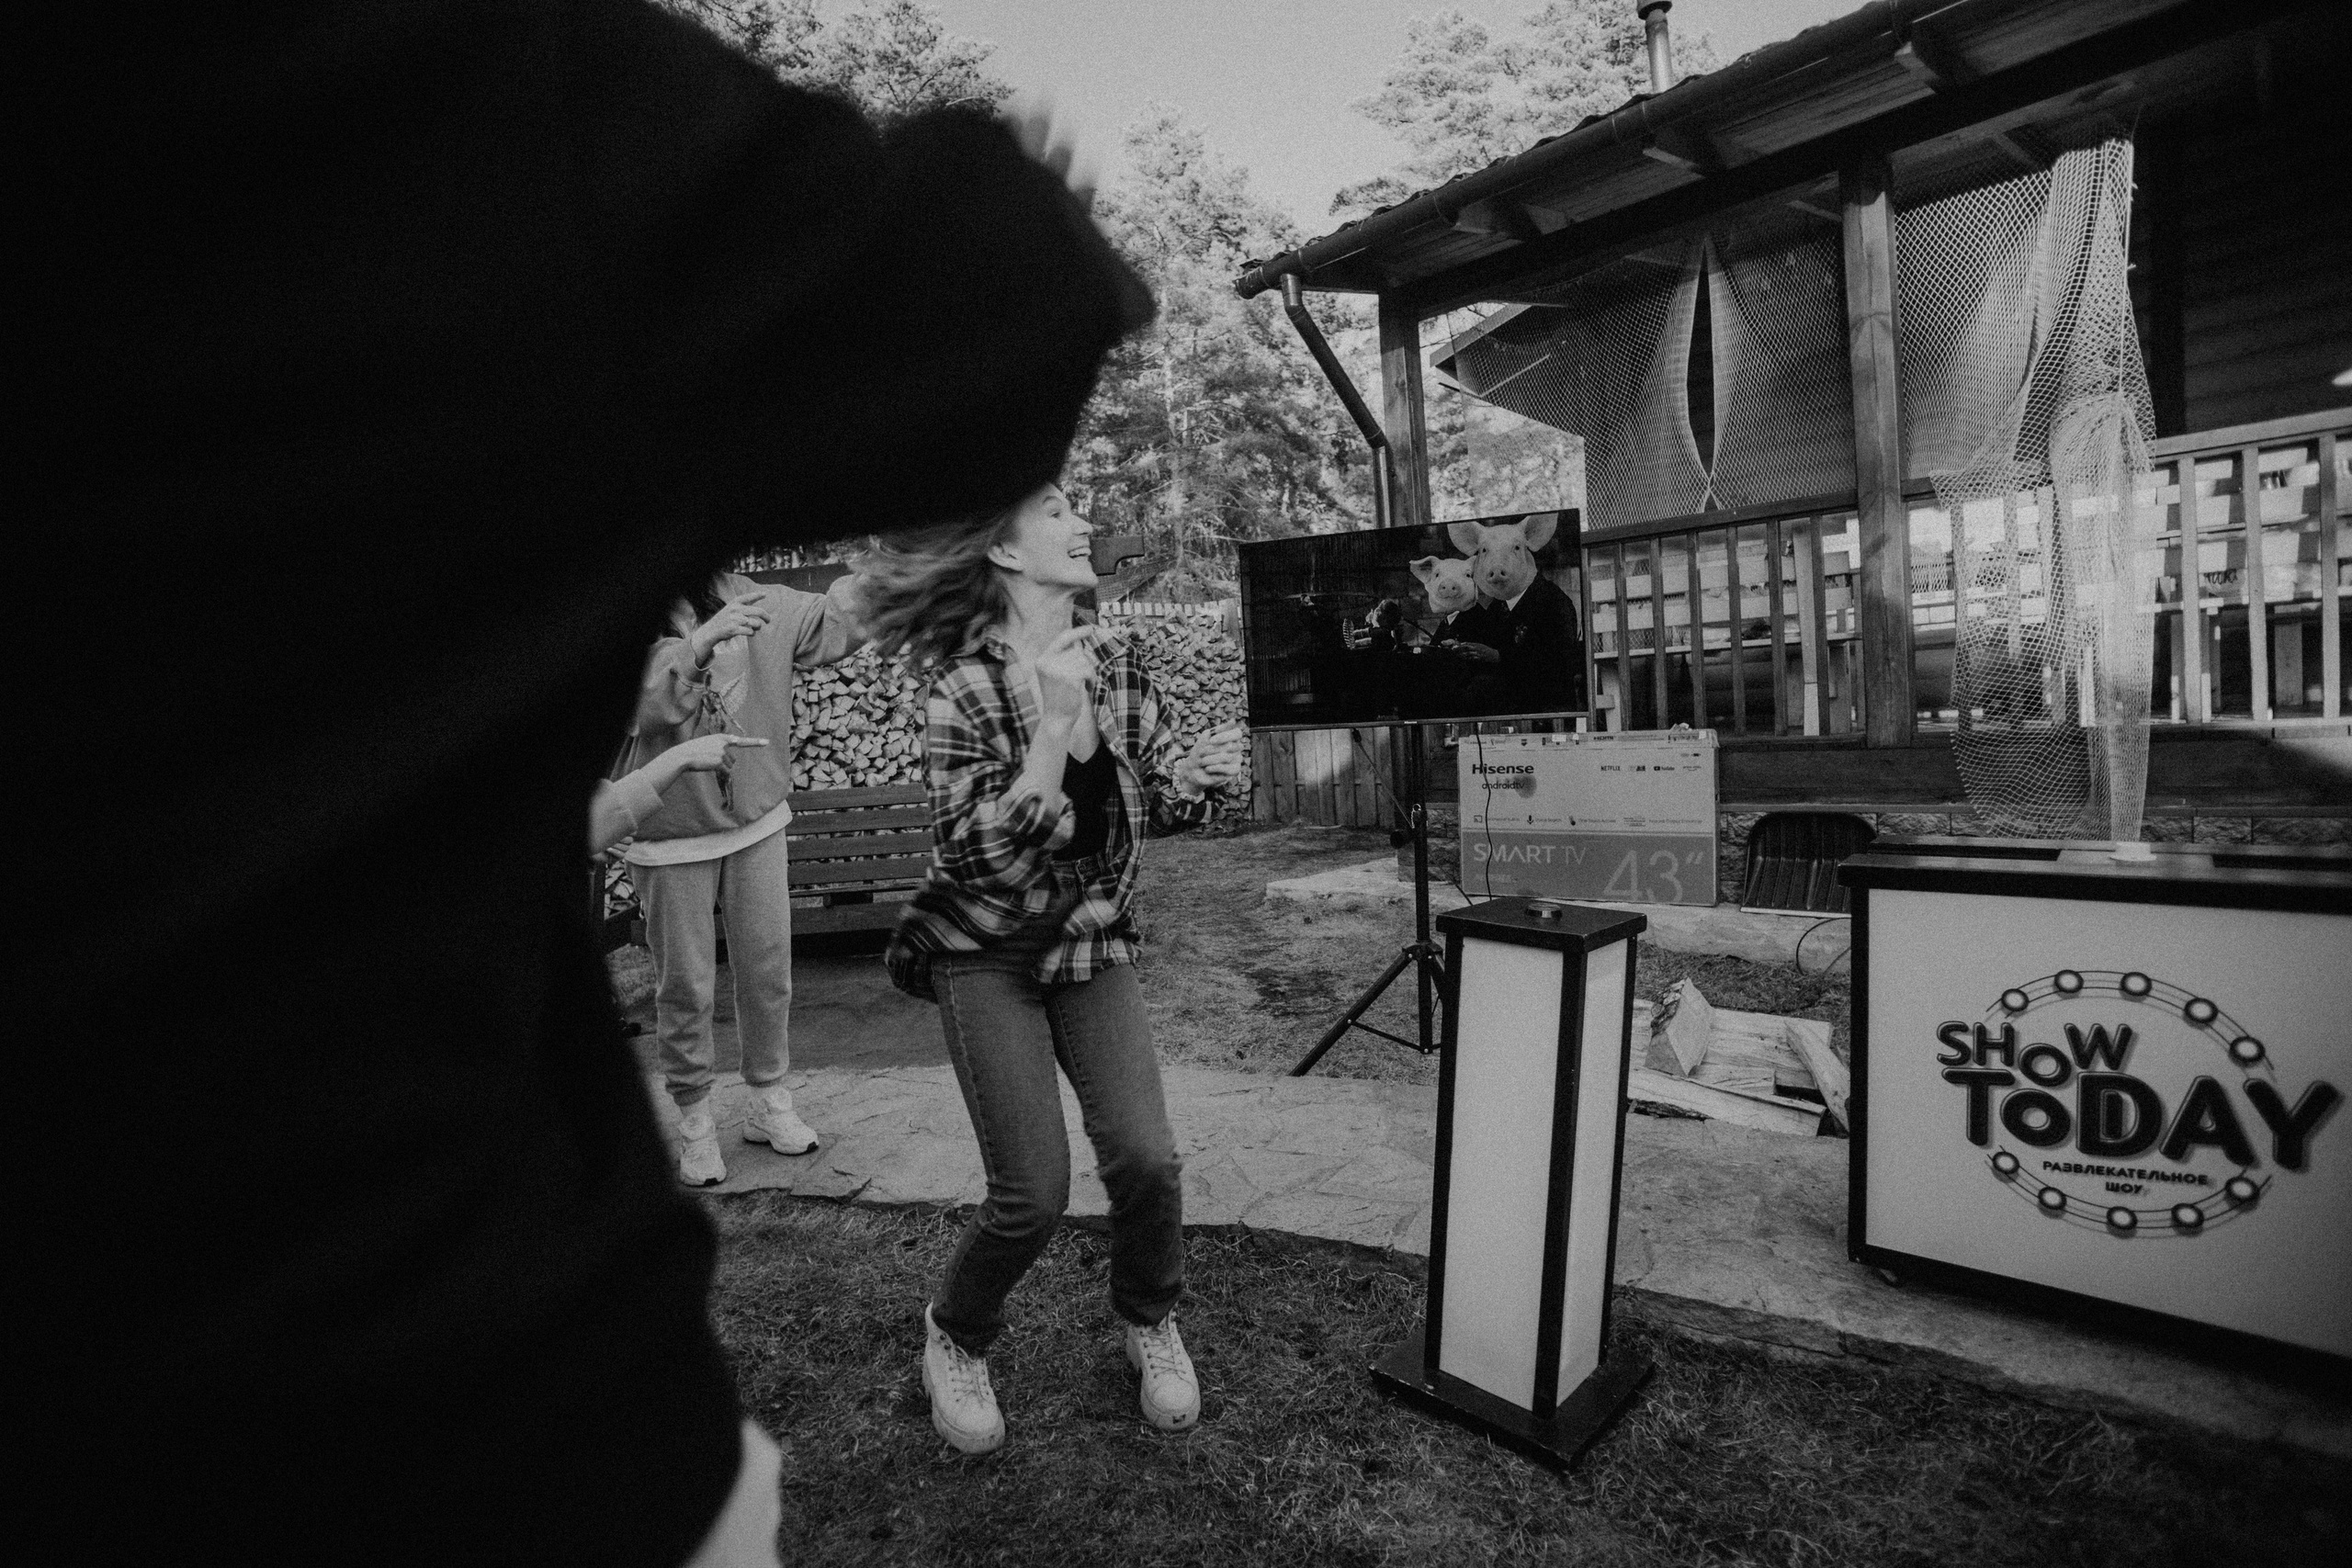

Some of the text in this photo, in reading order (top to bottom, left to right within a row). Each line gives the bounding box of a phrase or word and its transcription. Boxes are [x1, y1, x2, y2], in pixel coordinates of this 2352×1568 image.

[1472, 763, 1534, 774] Hisense
[1473, 842, 1587, 865] SMART TV
[1936, 1020, 2135, 1088] SHOW
[1941, 1067, 2342, 1172] TODAY
[2042, 1161, 2209, 1186] РАЗВЛЕКАТЕЛЬНОЕ
[2105, 1181, 2143, 1194] ШОУ
